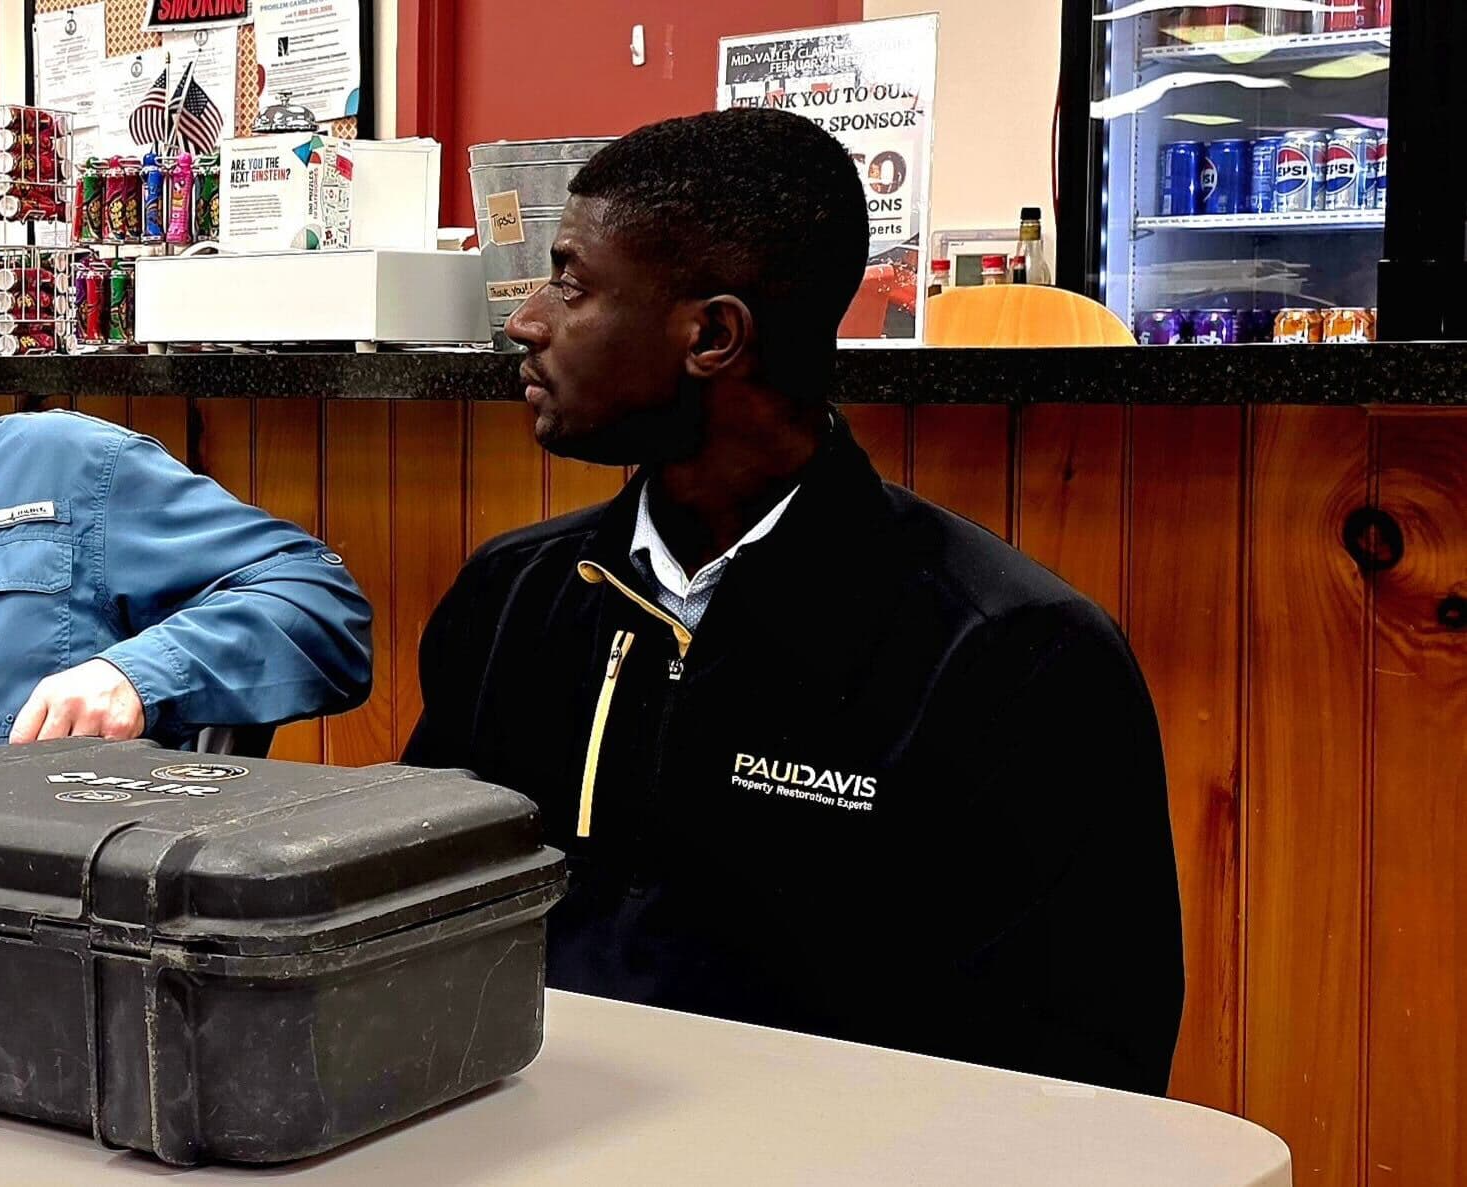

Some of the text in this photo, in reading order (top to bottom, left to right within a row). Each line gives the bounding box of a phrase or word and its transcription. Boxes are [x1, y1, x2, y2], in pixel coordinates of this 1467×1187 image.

[157, 0, 246, 20] SMOKING
[730, 46, 794, 66] MID-VALLEY
[770, 58, 826, 74] FEBRUARY
[800, 88, 839, 108] YOU
[843, 86, 868, 103] TO
[829, 110, 916, 133] SPONSOR
[231, 156, 280, 171] ARE YOU THE
[1278, 165, 1308, 177] EPSI
[230, 168, 291, 183] NEXT EINSTEIN?
[868, 198, 902, 212] ONS
[870, 223, 902, 236] perts
[731, 775, 873, 811] Property Restoration Experts
